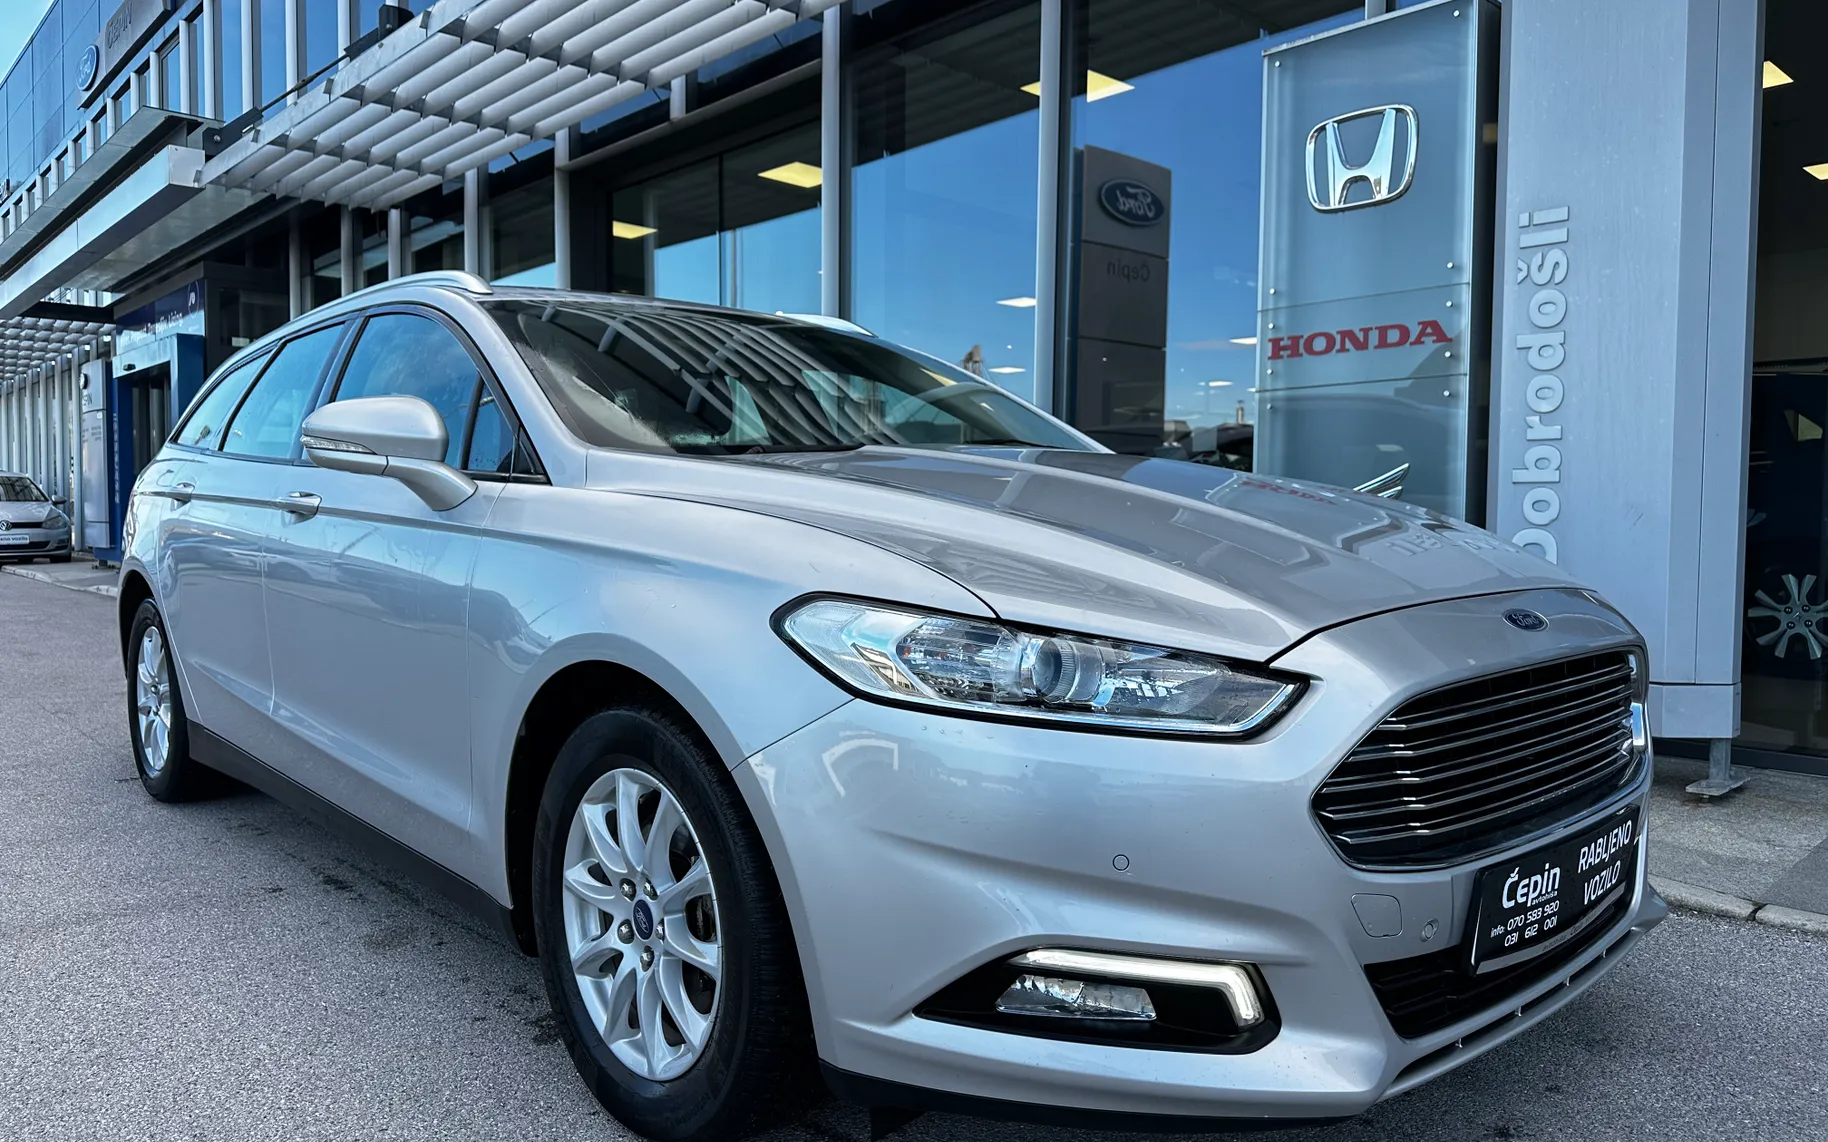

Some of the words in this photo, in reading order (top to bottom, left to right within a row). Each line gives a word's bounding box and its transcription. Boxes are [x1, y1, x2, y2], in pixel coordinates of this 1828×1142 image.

[1267, 319, 1453, 360] HONDA
[1577, 820, 1632, 873] RABLJENO
[1502, 862, 1561, 909] Čepin
[1583, 860, 1621, 905] VOZILO
[1504, 931, 1519, 947] 031
[1524, 923, 1539, 938] 612
[1543, 915, 1558, 931] 001
[1507, 914, 1525, 931] 070
[1525, 907, 1543, 924] 583
[1543, 900, 1560, 916] 920
